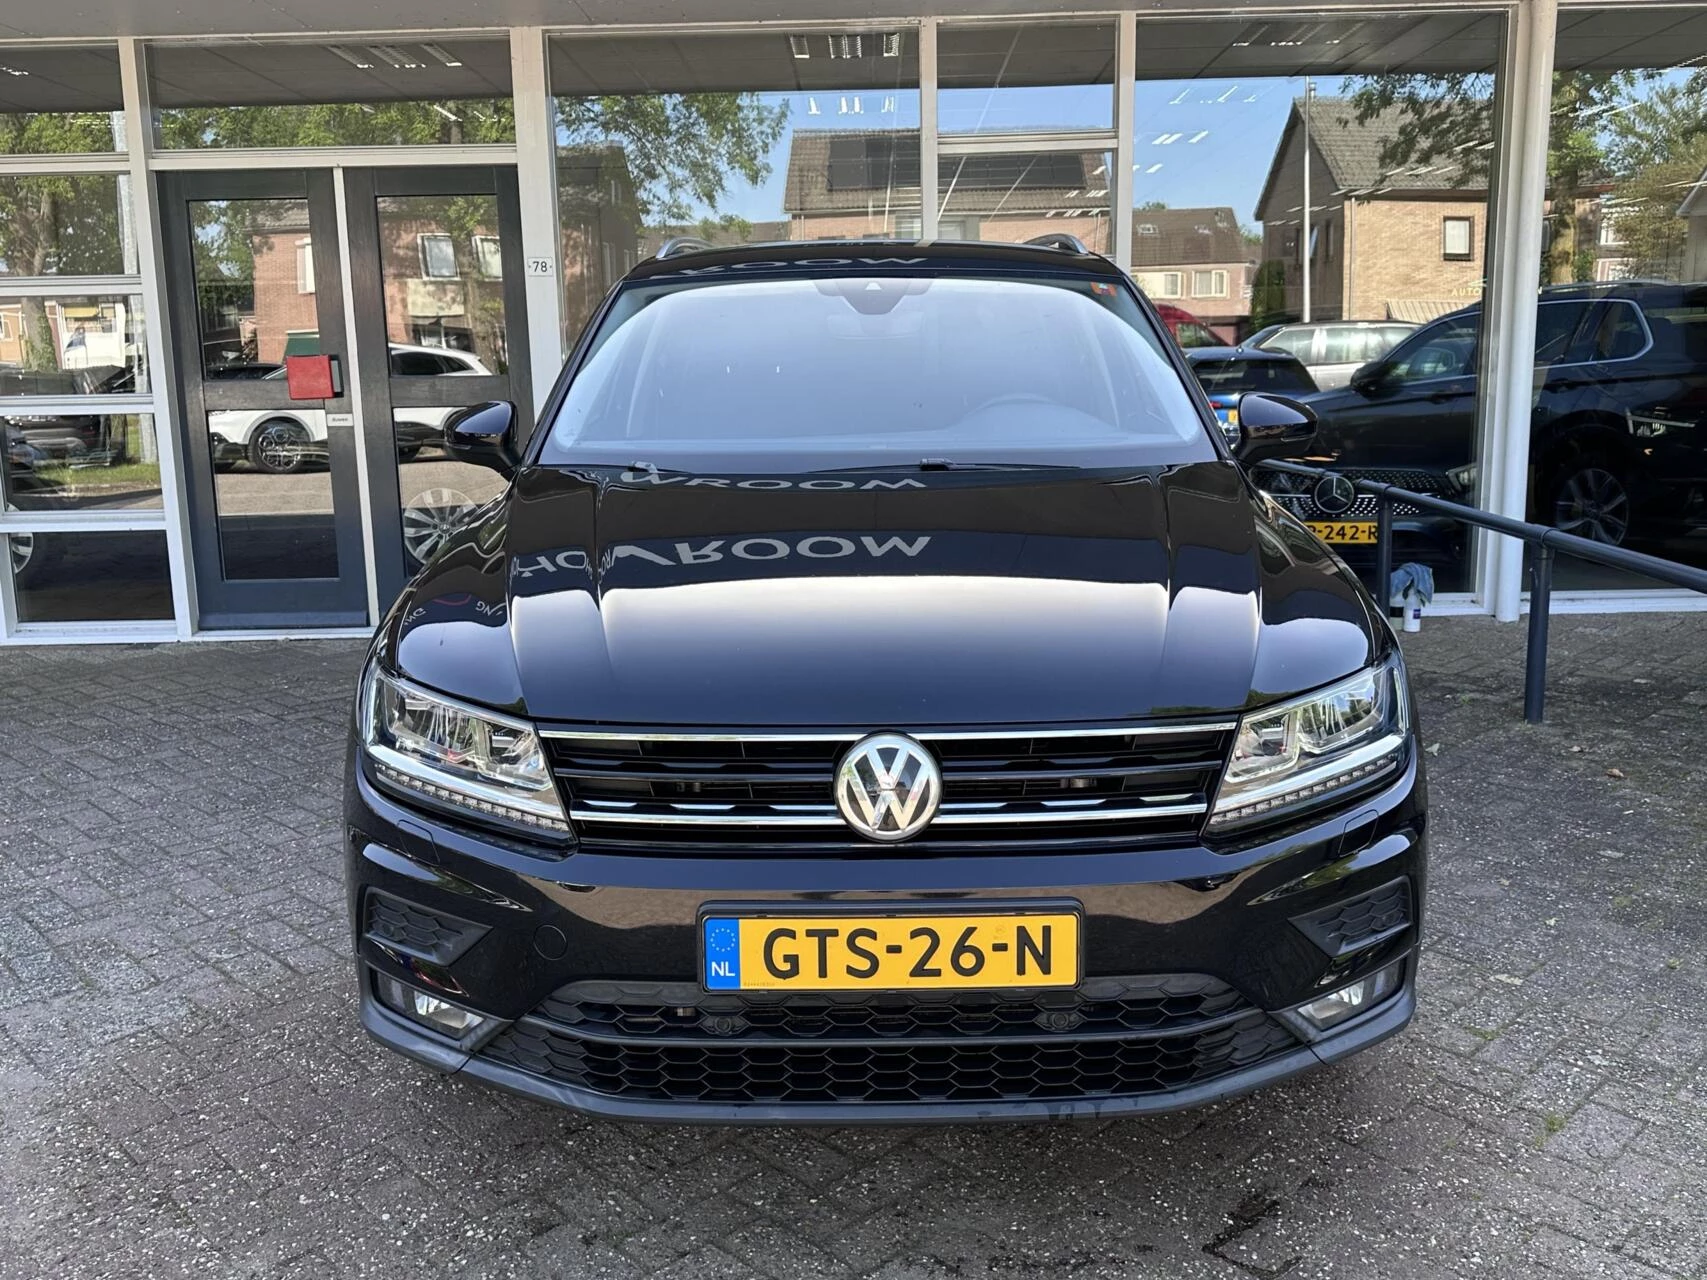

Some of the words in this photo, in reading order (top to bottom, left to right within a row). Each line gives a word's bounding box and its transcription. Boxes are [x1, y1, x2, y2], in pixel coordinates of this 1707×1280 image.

[533, 261, 547, 272] 78
[763, 925, 1052, 979] GTS-26-N
[711, 962, 735, 977] NL
